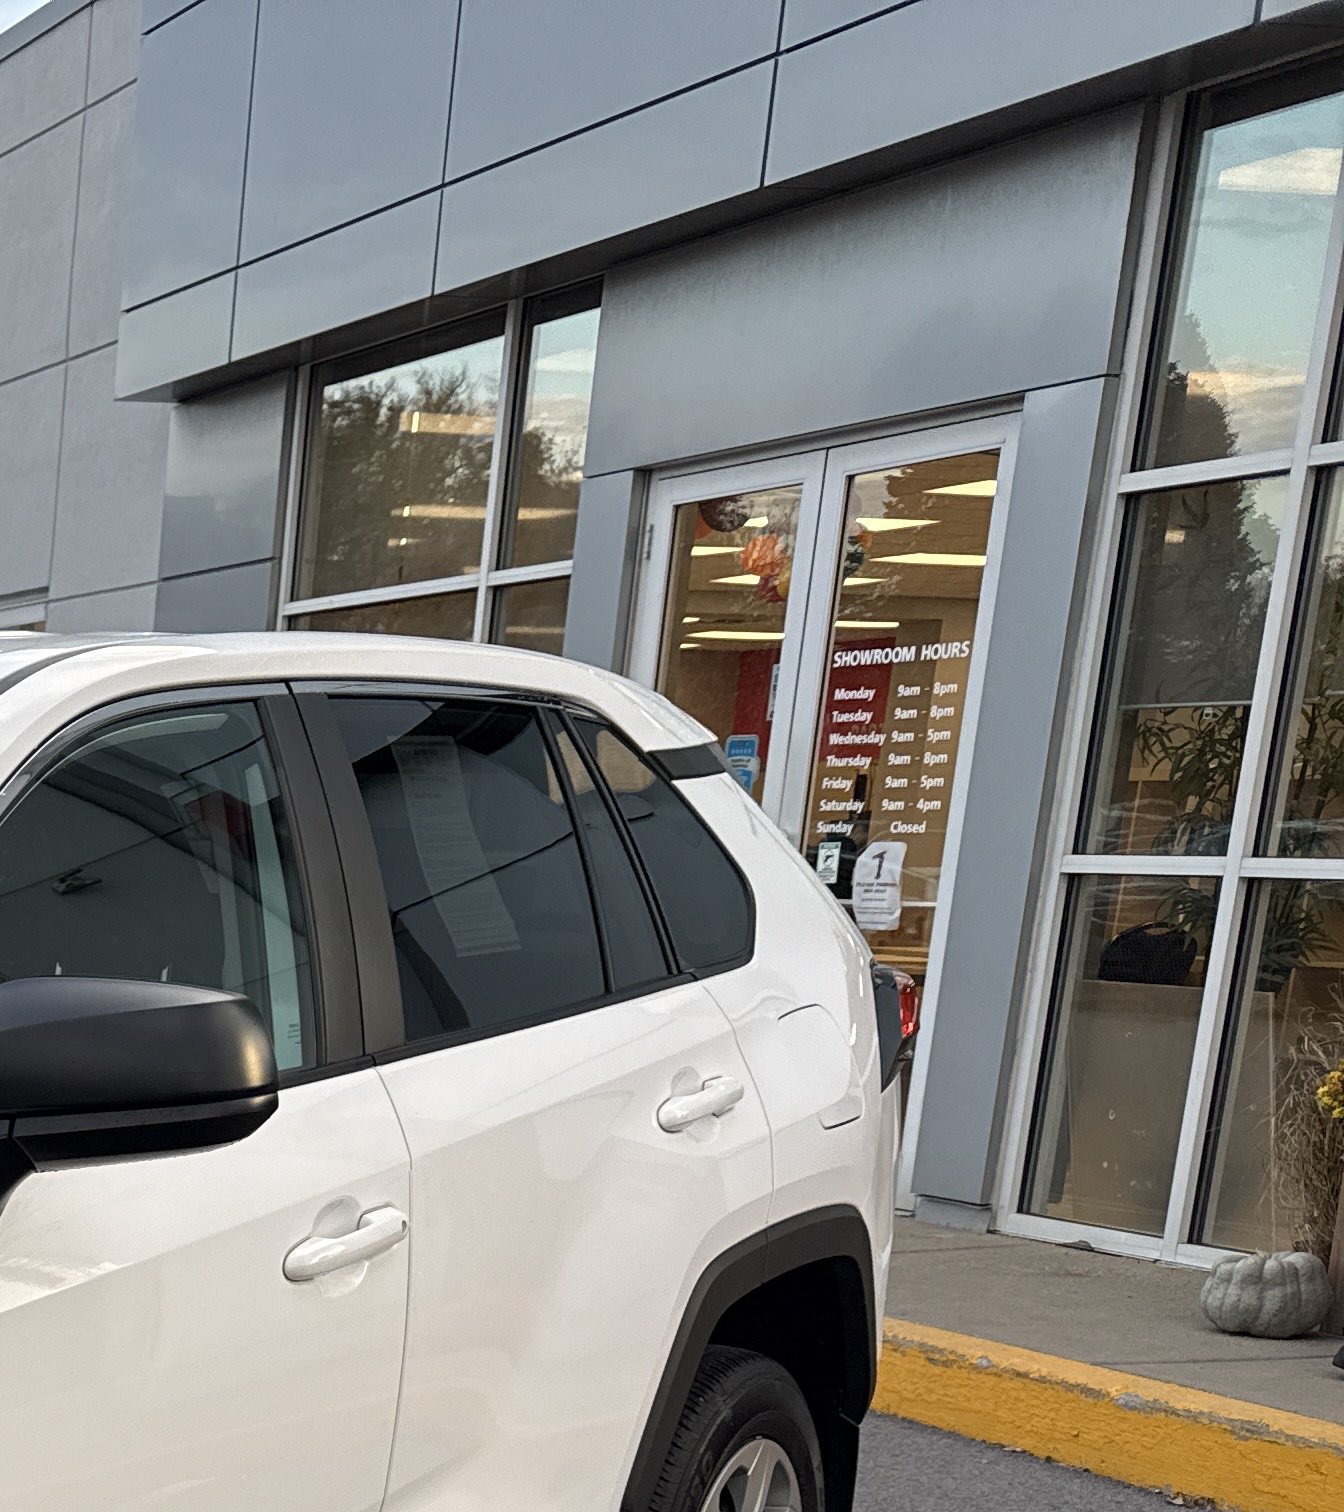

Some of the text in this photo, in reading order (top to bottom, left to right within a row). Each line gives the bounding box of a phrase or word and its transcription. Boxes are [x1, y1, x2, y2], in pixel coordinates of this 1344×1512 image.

[832, 641, 971, 668] SHOWROOM HOURS
[834, 686, 876, 701] Monday
[897, 685, 921, 697] 9am
[932, 682, 958, 696] 8pm
[831, 709, 873, 724] Tuesday
[893, 707, 917, 720] 9am
[930, 705, 955, 720] 8pm
[828, 731, 887, 746] Wednesday
[891, 730, 914, 743] 9am
[926, 729, 951, 743] 5pm
[825, 754, 872, 769] Thursday
[887, 753, 911, 765] 9am
[923, 752, 948, 766] 8pm
[821, 778, 853, 791] Friday
[884, 776, 908, 788] 9am
[920, 775, 945, 789] 5pm
[819, 799, 865, 814] Saturday
[881, 799, 905, 811] 9am
[916, 798, 942, 812] 4pm
[816, 821, 927, 836] Sunday Closed
